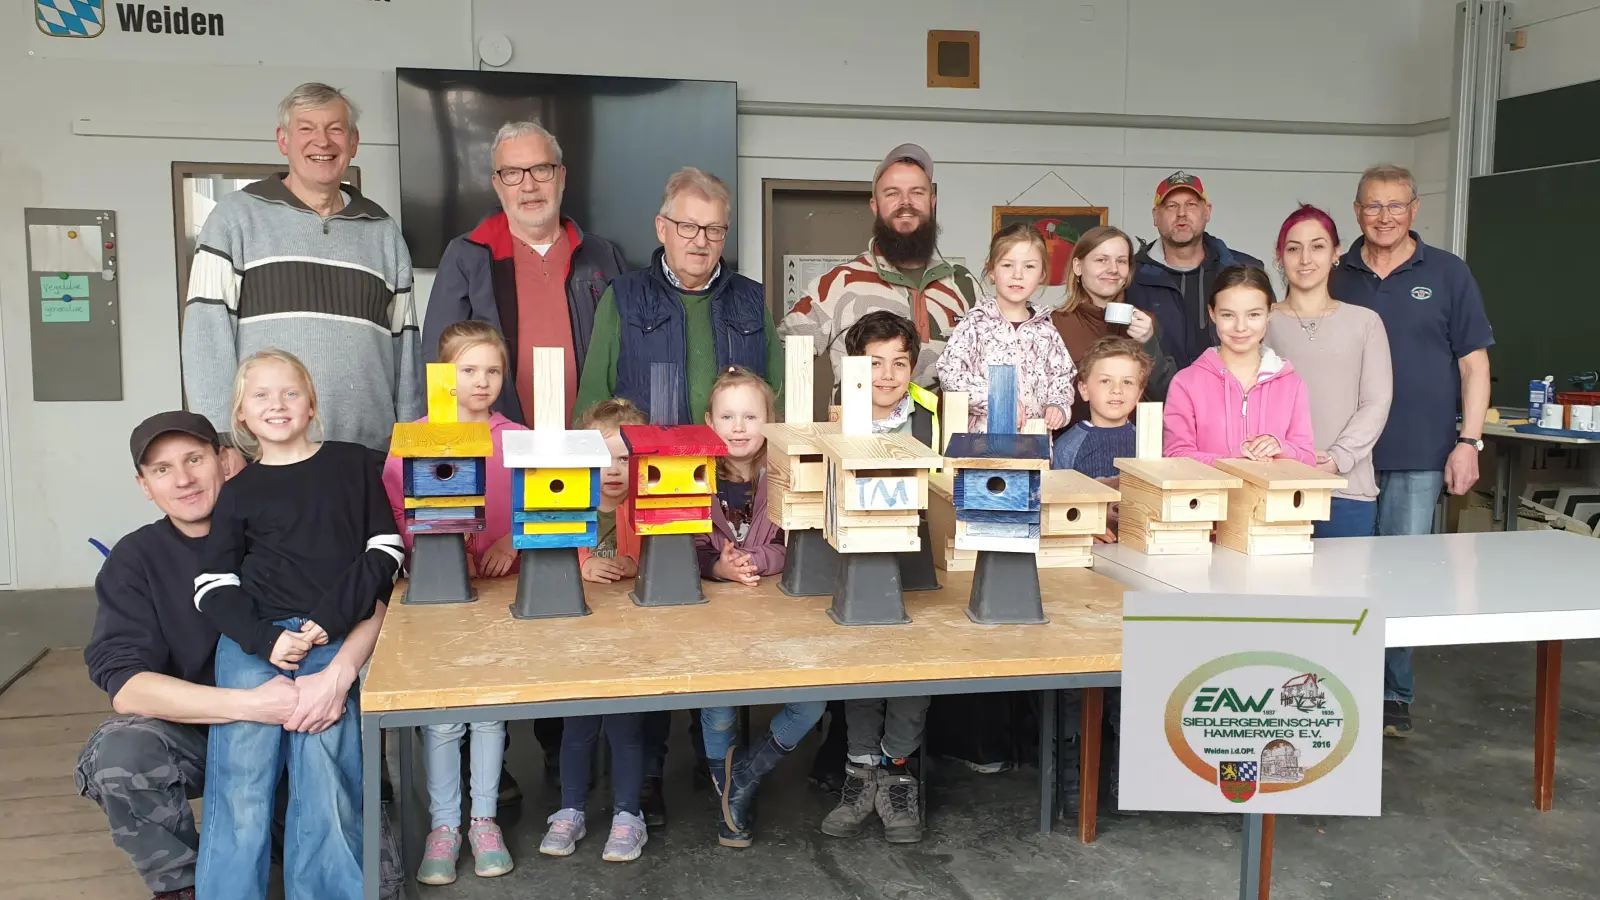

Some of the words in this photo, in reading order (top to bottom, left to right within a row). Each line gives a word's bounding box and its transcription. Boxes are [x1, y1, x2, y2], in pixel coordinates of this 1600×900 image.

[116, 3, 224, 36] Weiden
[855, 478, 909, 508] TM
[1193, 688, 1274, 712] EAW
[1183, 718, 1343, 727] SIEDLERGEMEINSCHAFT
[1204, 729, 1294, 738] HAMMERWEG
[1299, 730, 1321, 738] E.V.
